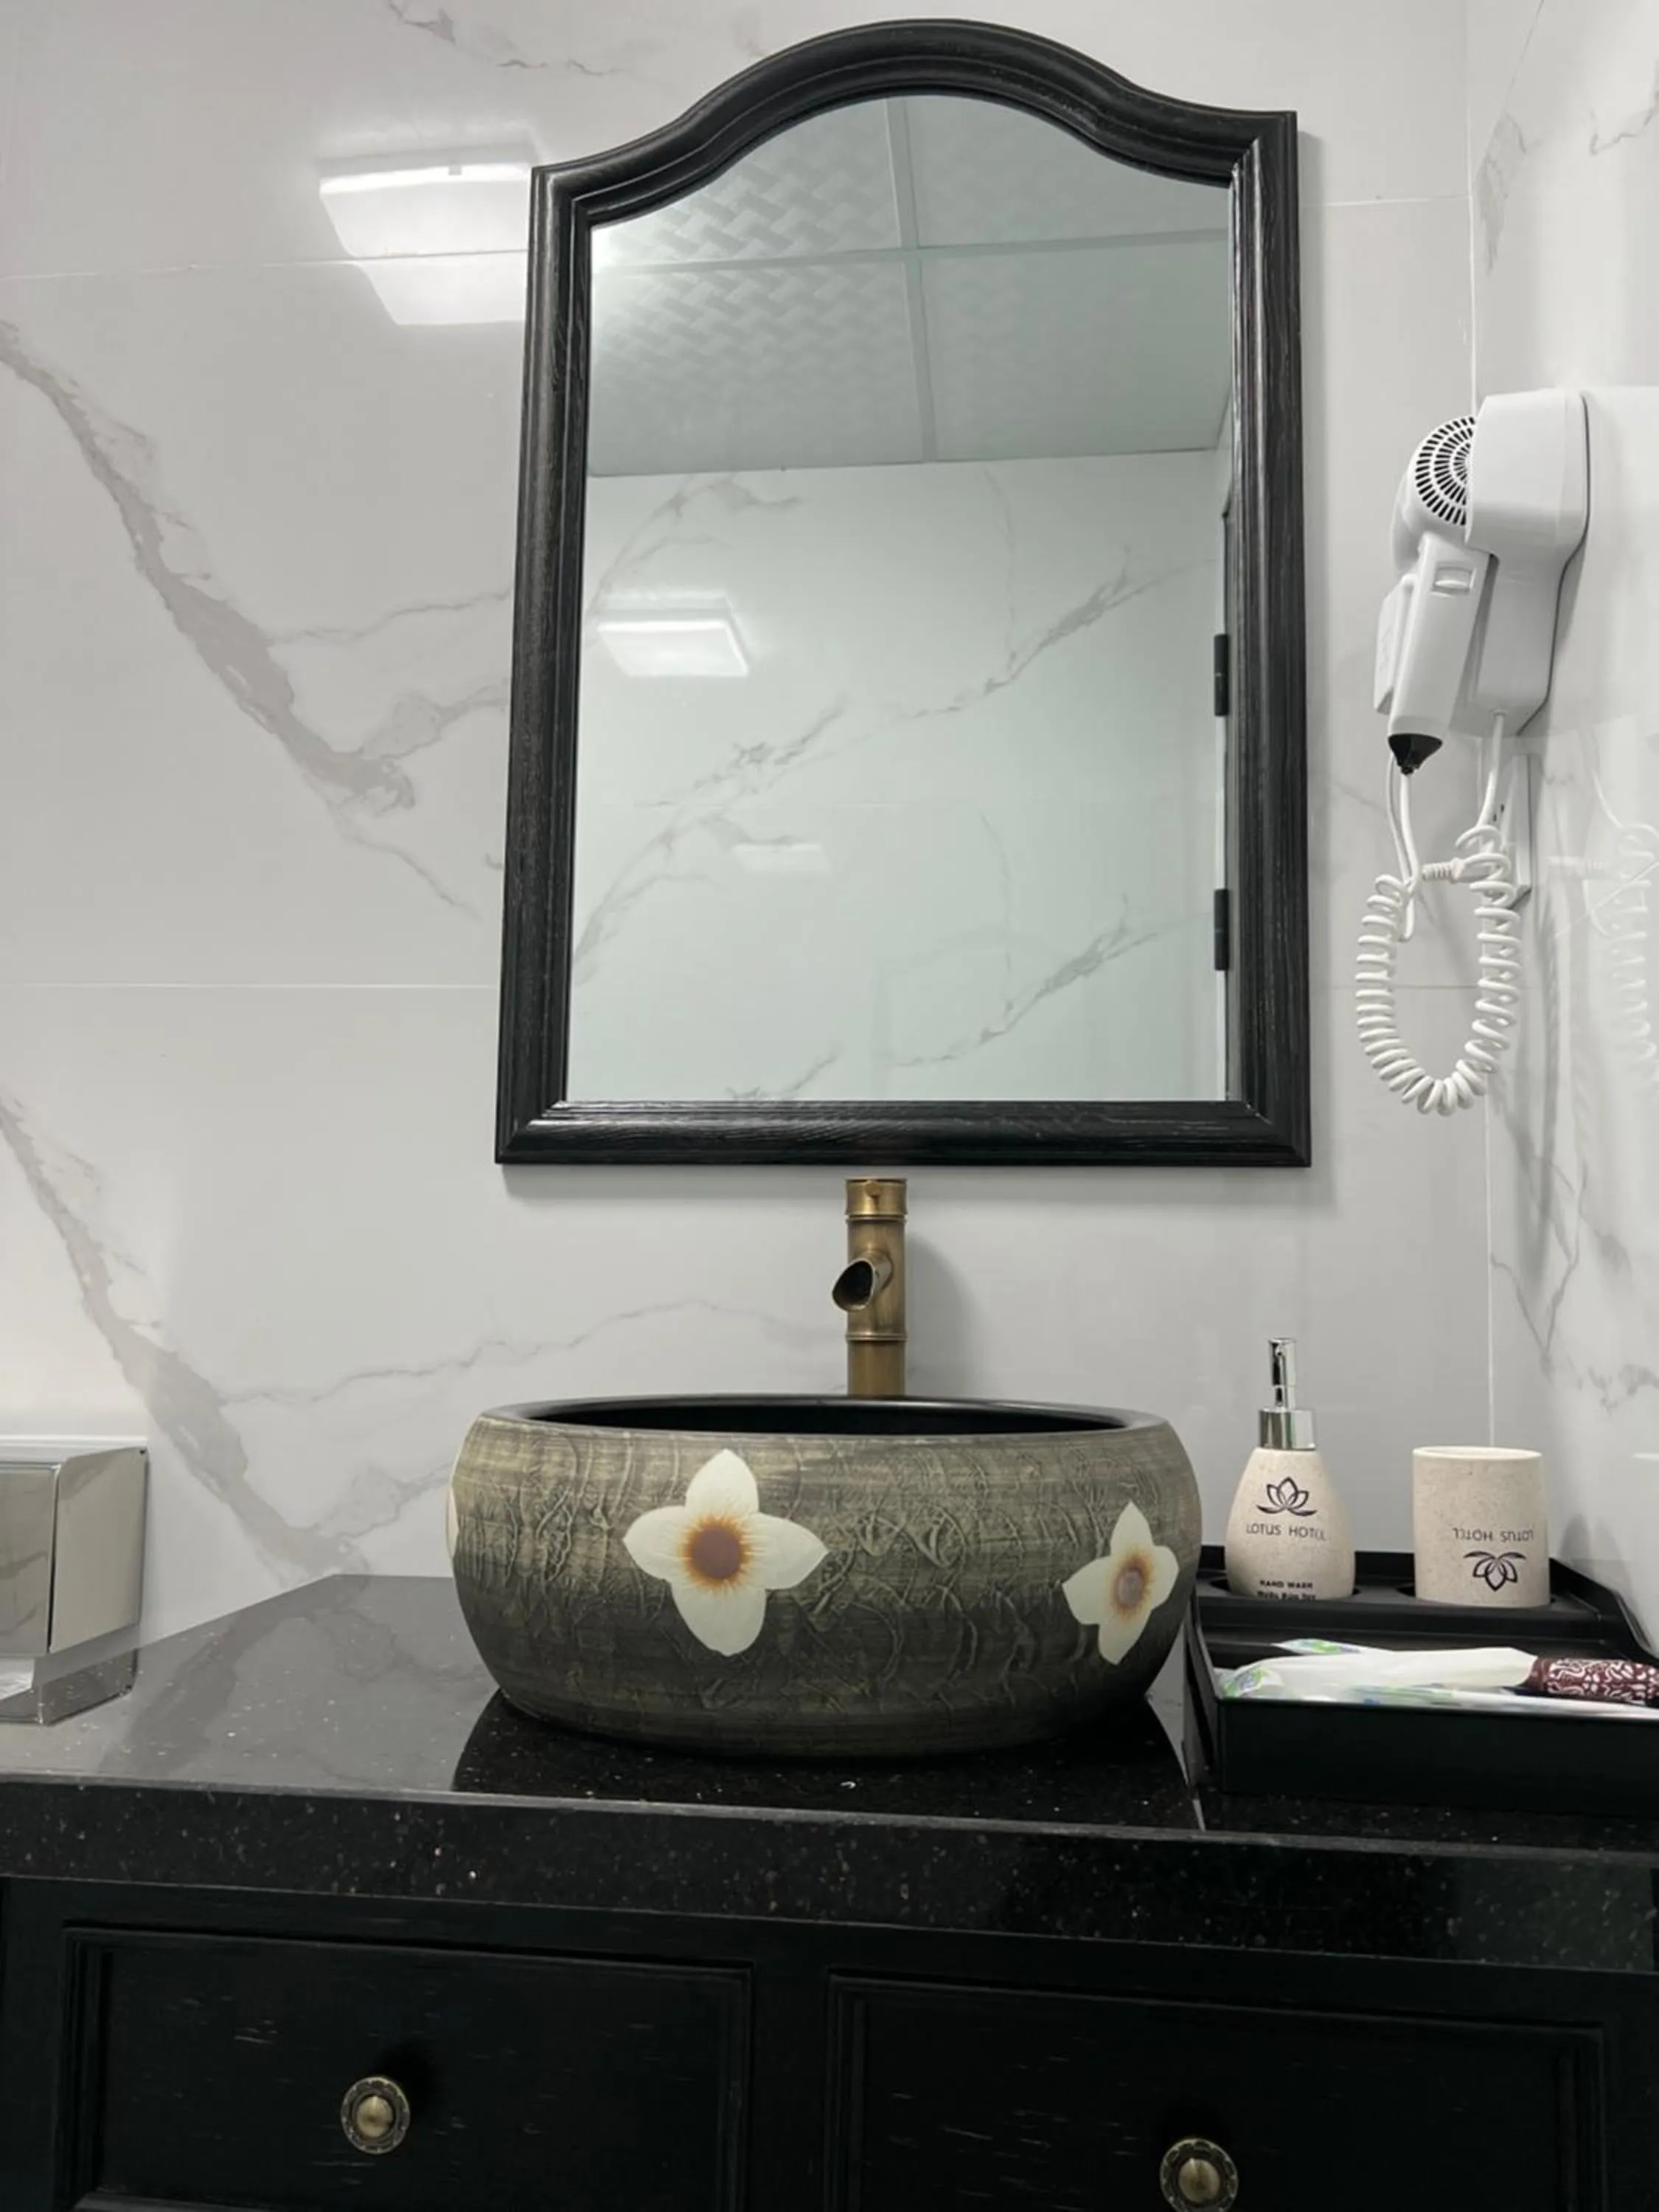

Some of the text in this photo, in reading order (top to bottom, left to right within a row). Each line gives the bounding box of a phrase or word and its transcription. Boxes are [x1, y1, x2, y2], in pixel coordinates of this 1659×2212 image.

[1246, 1523, 1326, 1542] LOTUS HOTEL
[1500, 1528, 1534, 1543] LOTUS
